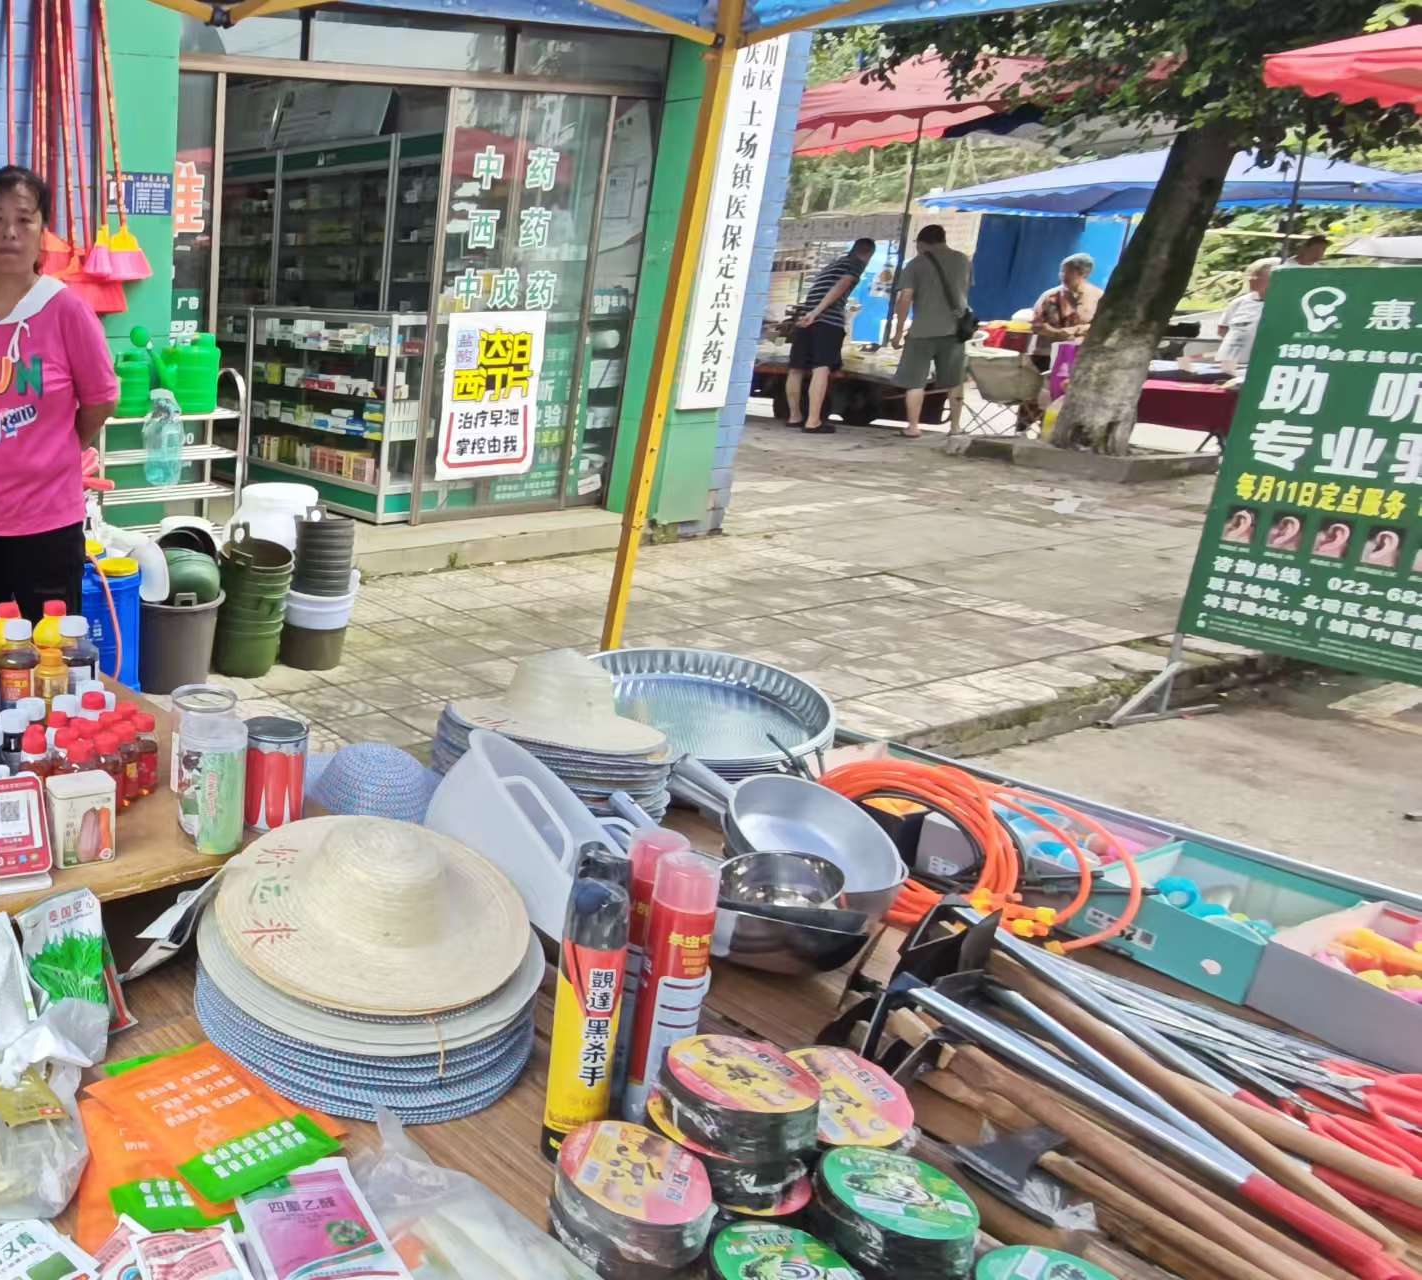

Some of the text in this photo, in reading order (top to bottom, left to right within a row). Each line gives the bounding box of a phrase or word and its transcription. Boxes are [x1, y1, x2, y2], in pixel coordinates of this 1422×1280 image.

[473, 145, 560, 191] 中药
[467, 206, 552, 249] 西药
[695, 100, 763, 393] 土场镇医保定点大药房
[454, 267, 557, 309] 中成药
[1364, 299, 1422, 331] 惠
[479, 328, 533, 366] 达泊
[452, 366, 534, 402] 西汀片
[457, 408, 520, 430] 治疗早泄
[455, 435, 518, 457] 掌控由我
[1235, 472, 1407, 520] 每月11日定点服务
